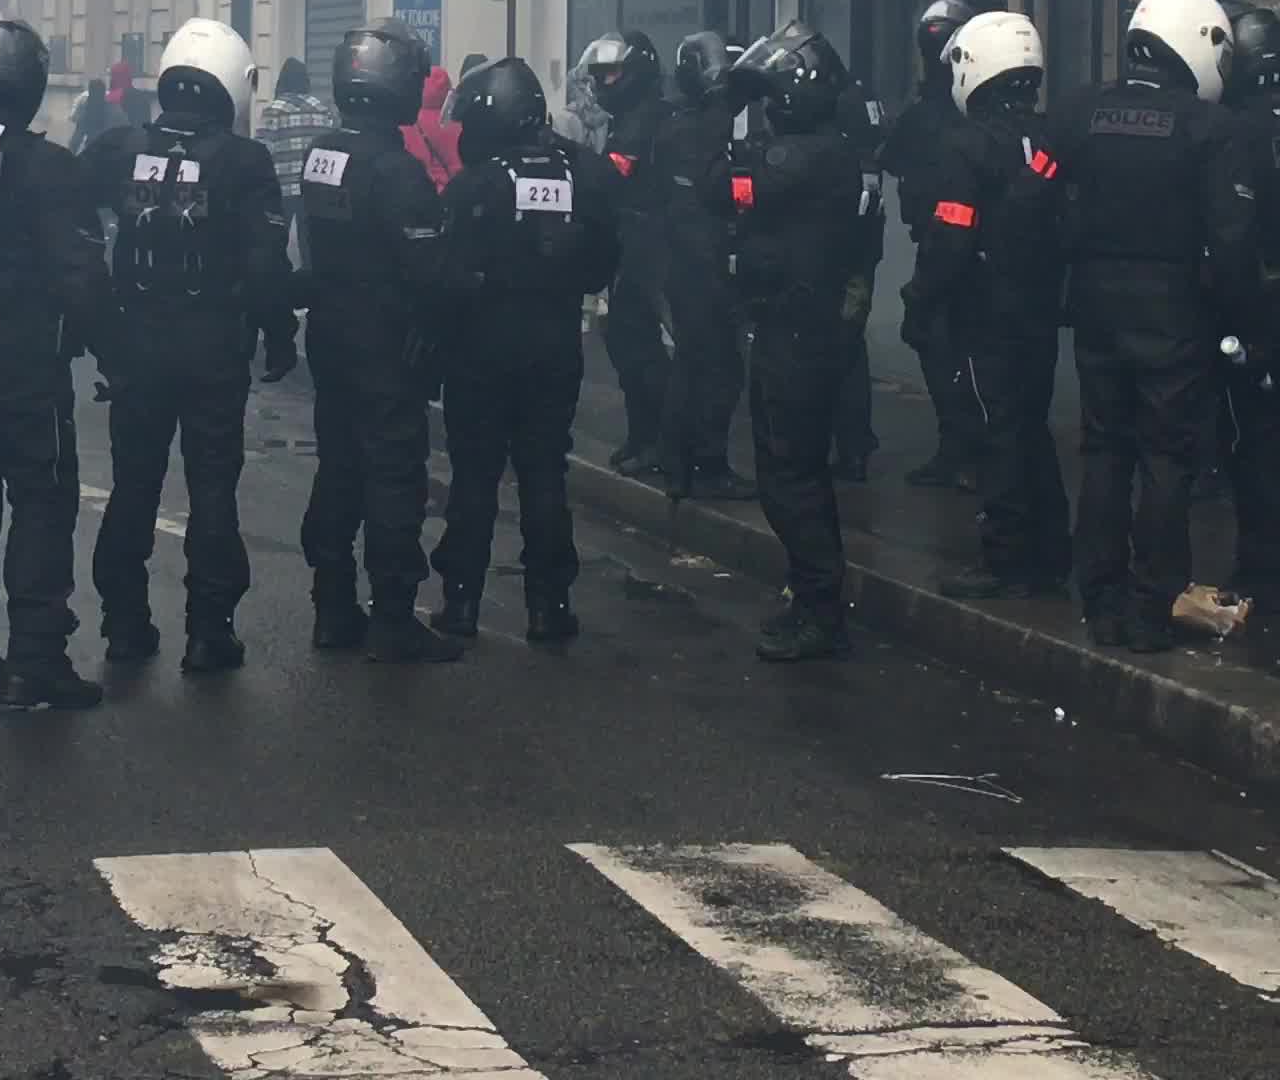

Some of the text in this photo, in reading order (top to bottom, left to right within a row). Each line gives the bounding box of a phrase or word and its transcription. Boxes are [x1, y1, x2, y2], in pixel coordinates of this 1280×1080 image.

[1093, 110, 1171, 130] POLICE
[148, 165, 185, 182] 21
[311, 158, 337, 175] 221
[529, 186, 561, 203] 221
